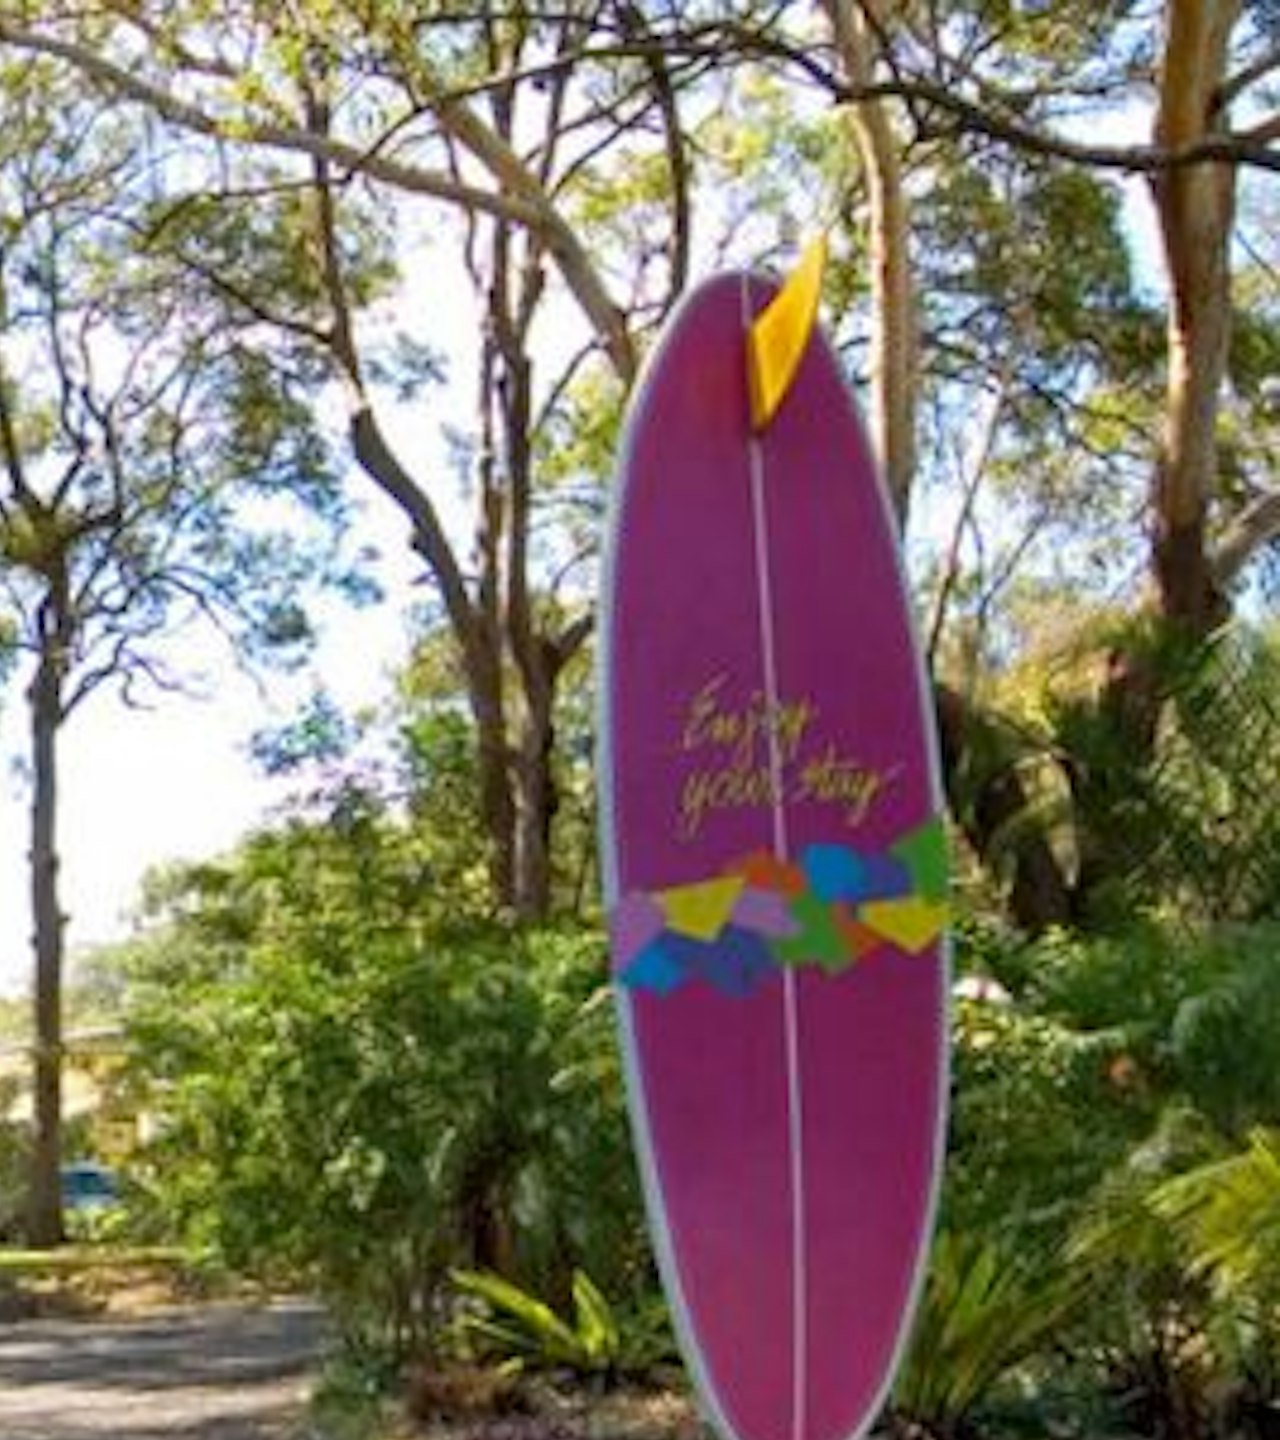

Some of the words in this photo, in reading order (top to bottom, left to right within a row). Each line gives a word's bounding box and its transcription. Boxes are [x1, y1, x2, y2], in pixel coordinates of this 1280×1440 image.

[681, 672, 812, 766] Enjoy
[678, 765, 784, 842] your
[792, 742, 906, 828] stay
